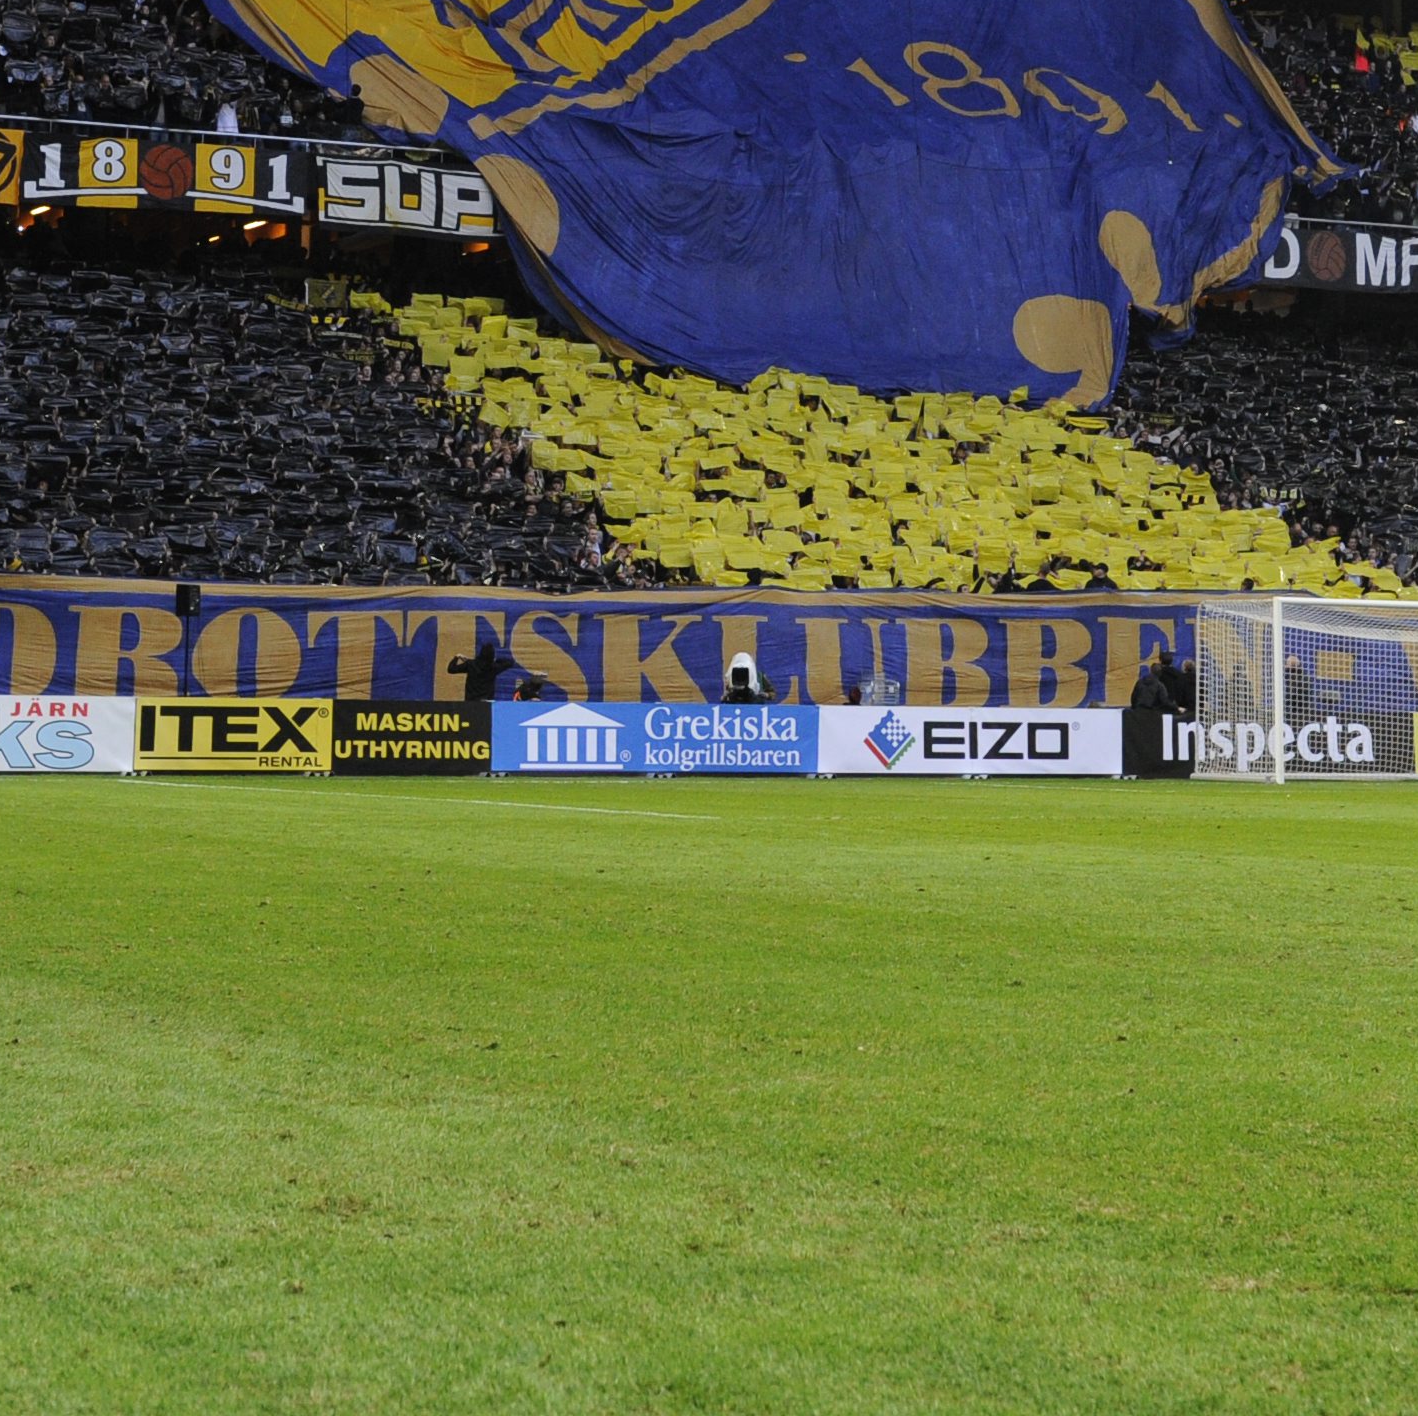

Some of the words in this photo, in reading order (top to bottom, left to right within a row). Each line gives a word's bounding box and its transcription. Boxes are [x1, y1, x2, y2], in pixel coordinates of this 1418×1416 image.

[10, 698, 89, 717] JÄRN
[140, 705, 319, 753] ITEX
[356, 713, 470, 732] MASKIN-
[644, 705, 799, 742] Grekiska
[334, 740, 490, 760] UTHYRNING
[923, 721, 1069, 760] EIZO
[1162, 713, 1375, 772] Inspecta
[258, 756, 323, 768] RENTAL
[644, 742, 800, 771] kolgrillsbaren
